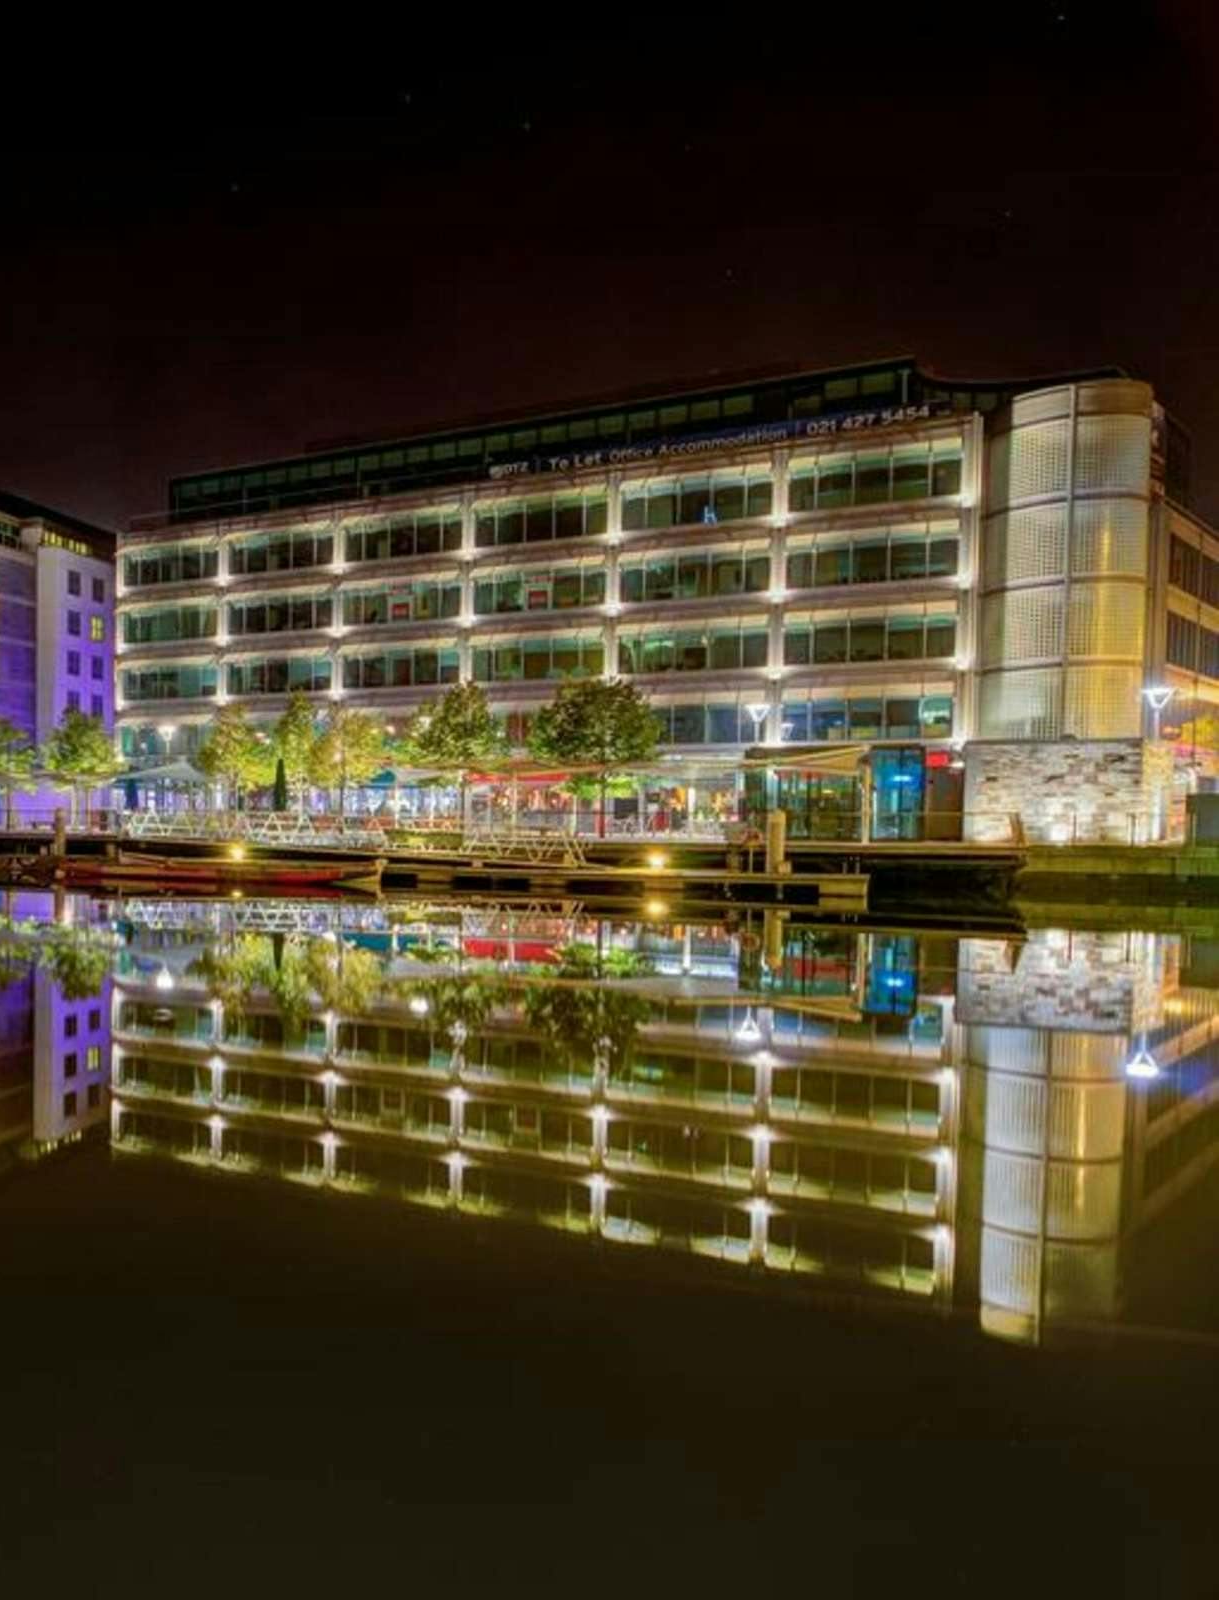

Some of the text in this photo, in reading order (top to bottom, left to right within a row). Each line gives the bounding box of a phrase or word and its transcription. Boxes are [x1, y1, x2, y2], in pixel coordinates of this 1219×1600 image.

[548, 456, 569, 470] To
[574, 452, 602, 466] Let
[609, 446, 654, 462] Office
[659, 428, 787, 454] Accommodation
[806, 420, 836, 435] 021
[842, 413, 876, 429] 427
